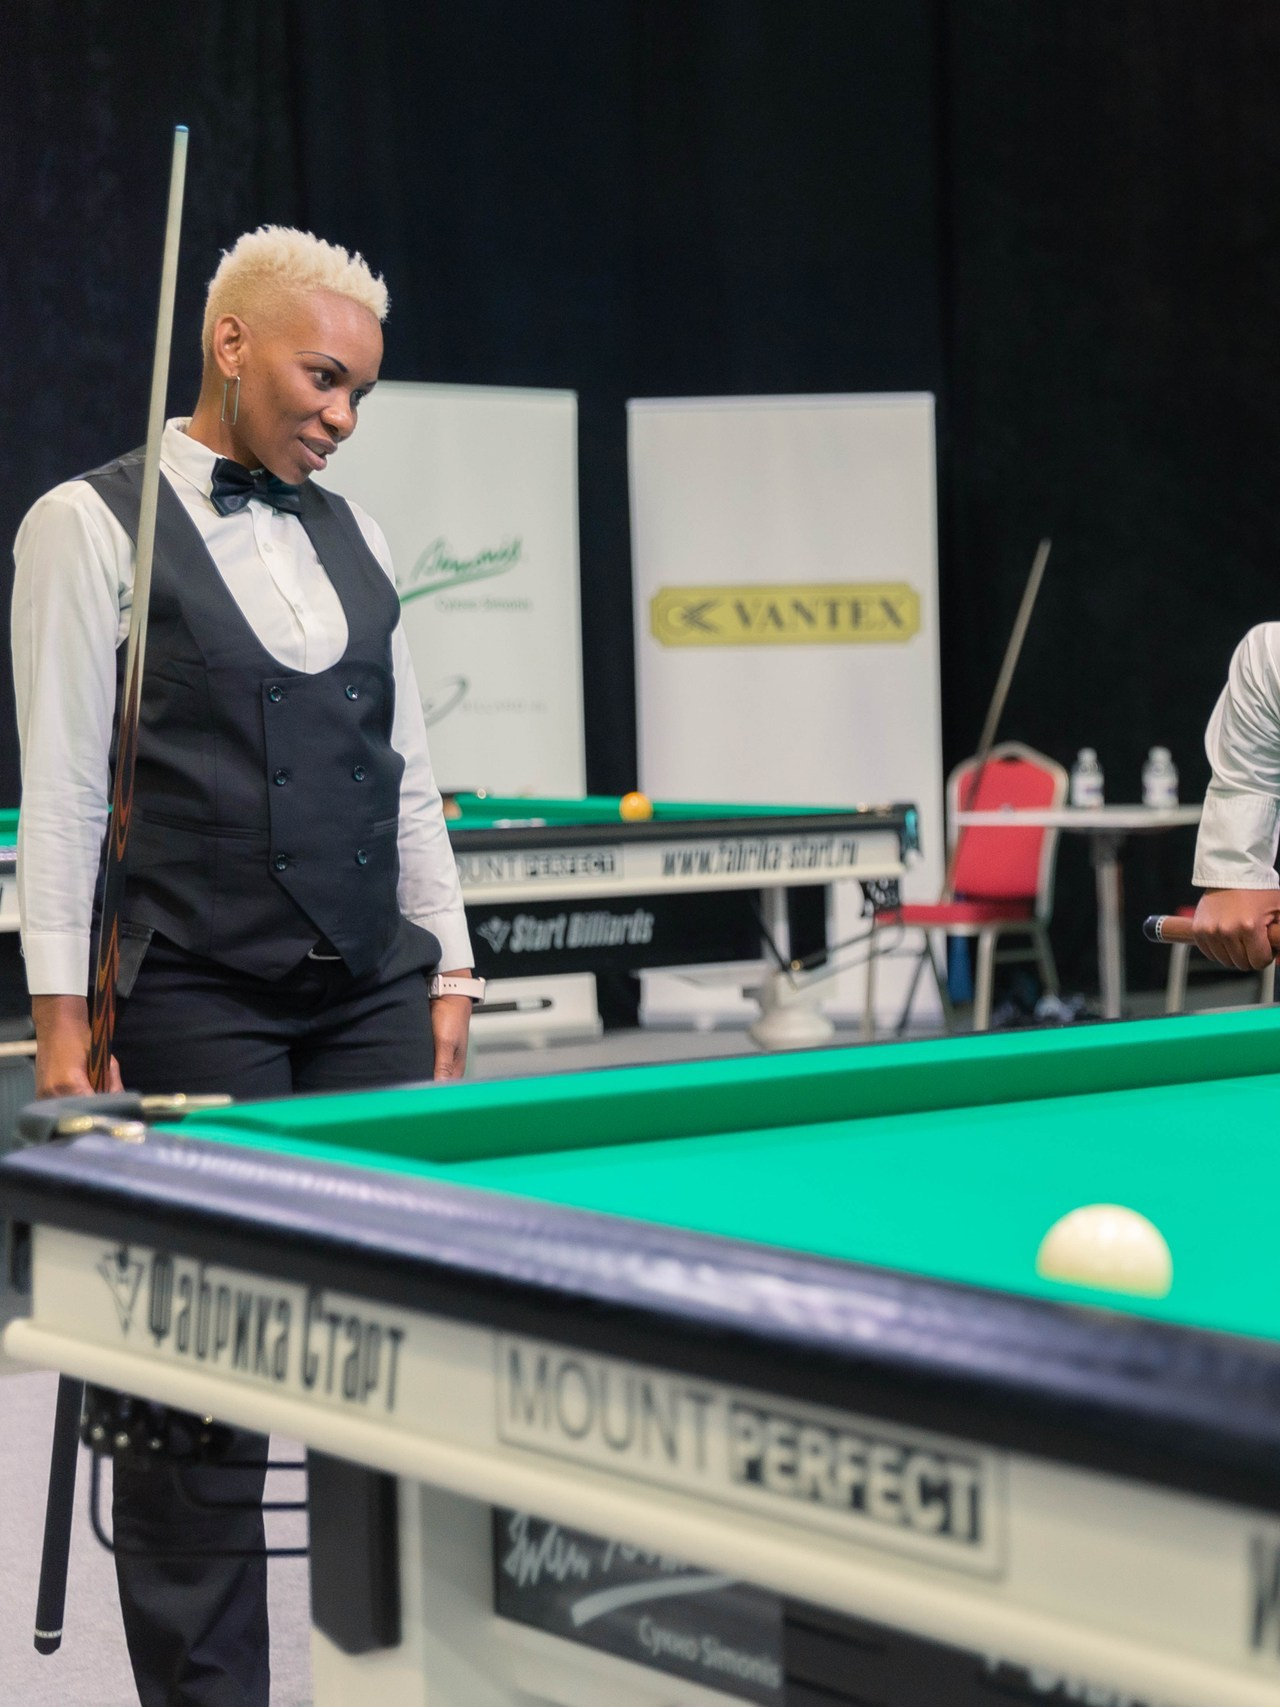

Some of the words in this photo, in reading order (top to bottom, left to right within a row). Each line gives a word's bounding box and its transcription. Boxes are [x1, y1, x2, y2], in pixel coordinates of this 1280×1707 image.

[733, 596, 905, 631] VANTEX
[662, 836, 858, 876] www.fabrika-start.ru
[509, 912, 567, 953] Start
[566, 908, 655, 949] Billiards
[148, 1248, 291, 1383] Фабрика
[300, 1286, 404, 1413] Старт
[508, 1344, 714, 1471] MOUNT
[731, 1401, 983, 1546] PERFECT
[701, 1633, 784, 1689] Simonis
